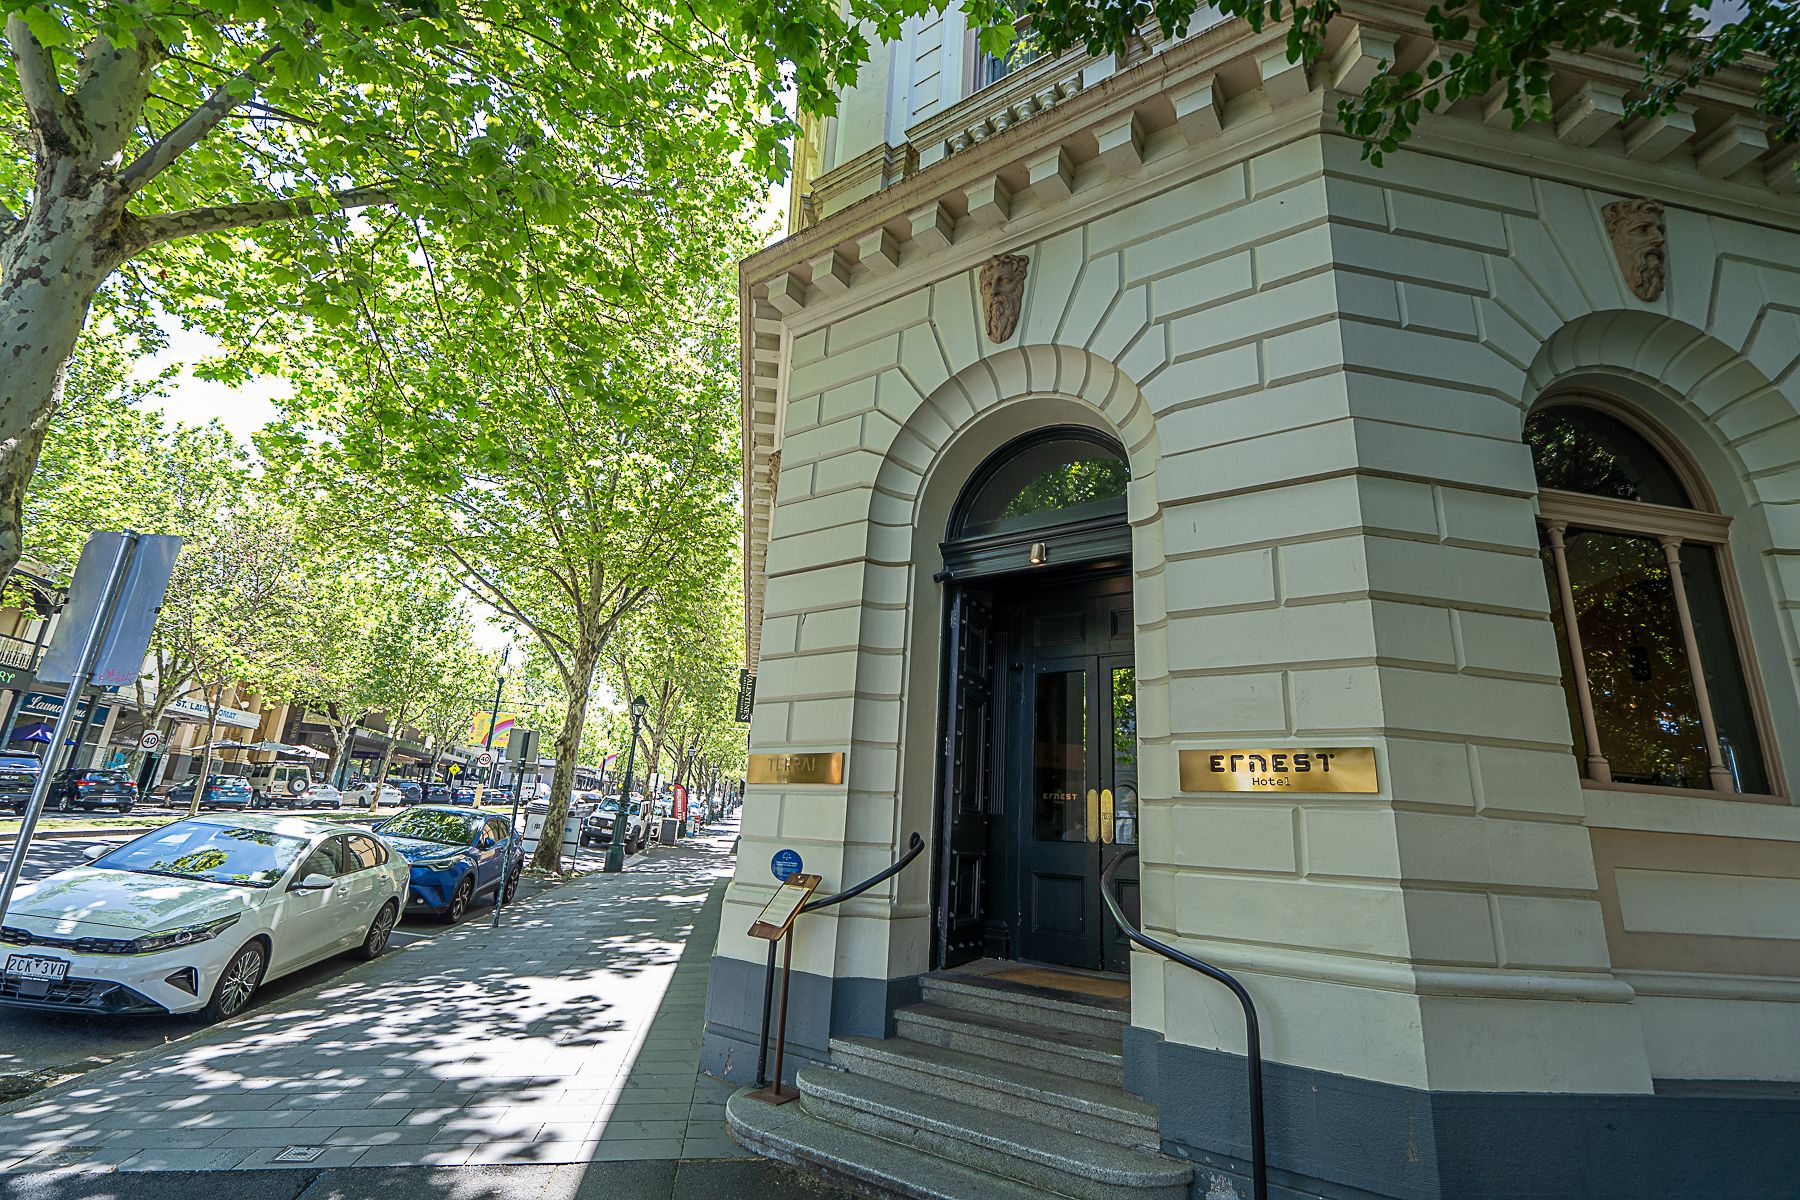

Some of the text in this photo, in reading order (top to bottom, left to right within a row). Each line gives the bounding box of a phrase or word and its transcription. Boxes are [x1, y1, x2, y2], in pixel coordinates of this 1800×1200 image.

[175, 700, 188, 708] ST.
[144, 737, 156, 745] 40
[1252, 776, 1291, 787] Hotel
[8, 958, 33, 973] 2CK
[41, 962, 65, 976] 3VD
